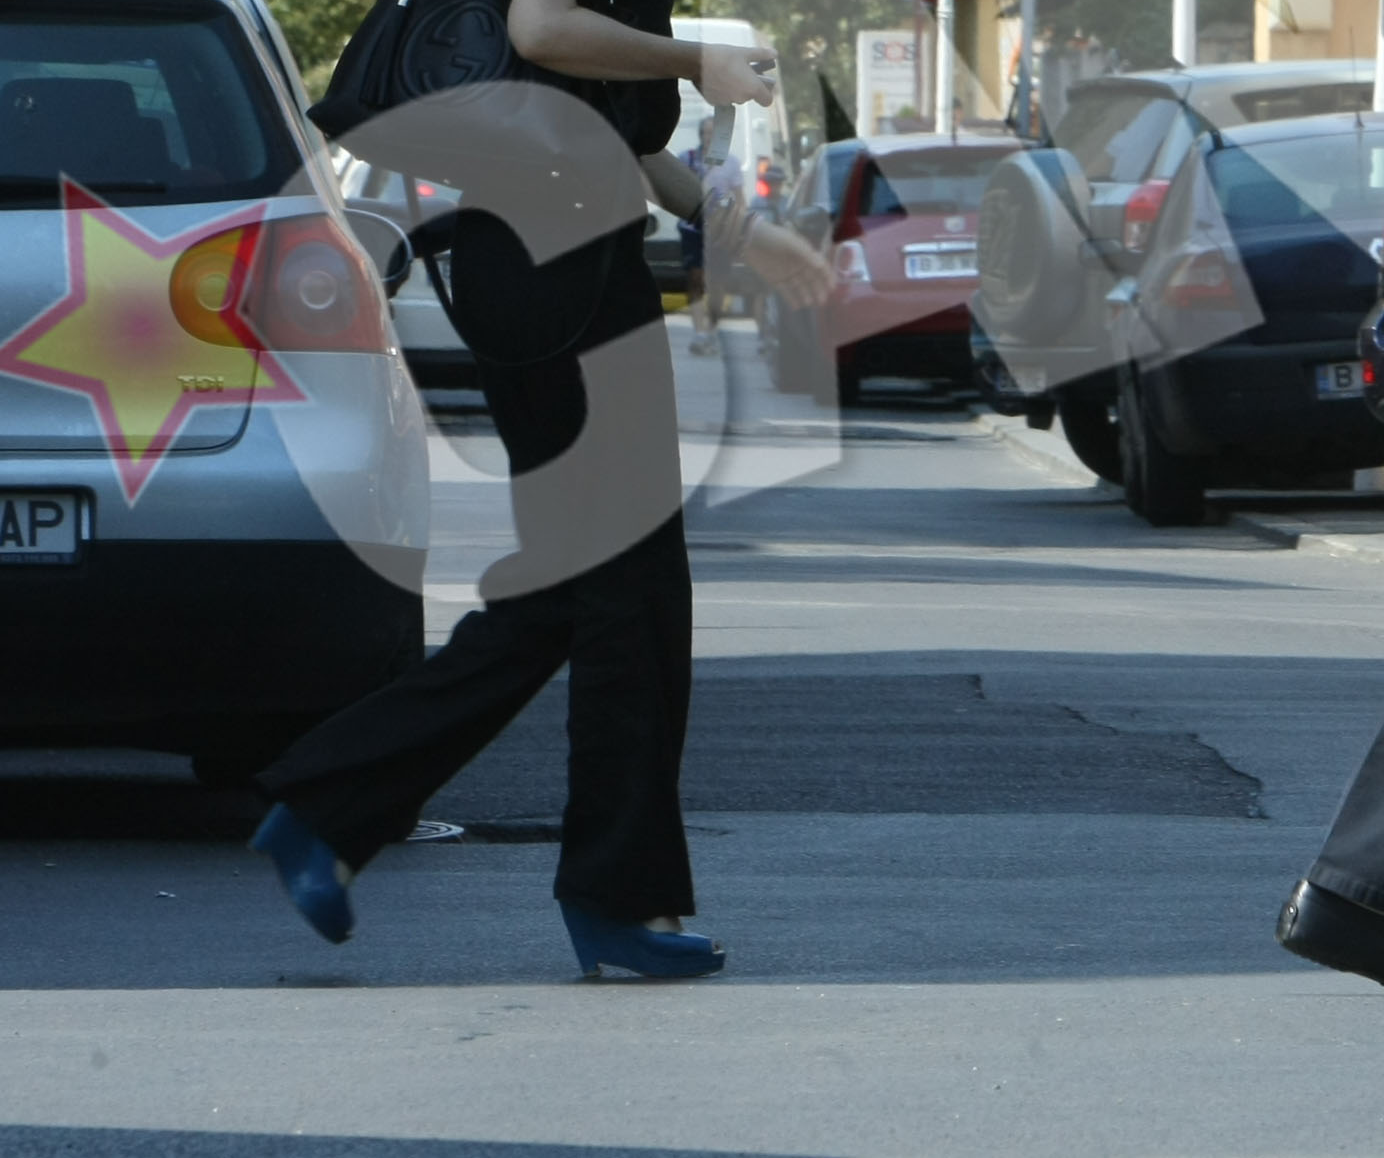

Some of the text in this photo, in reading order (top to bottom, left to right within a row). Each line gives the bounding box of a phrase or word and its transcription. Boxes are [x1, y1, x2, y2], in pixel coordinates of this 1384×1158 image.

[872, 40, 915, 63] SOS
[1335, 364, 1353, 389] B
[0, 498, 65, 548] AP
